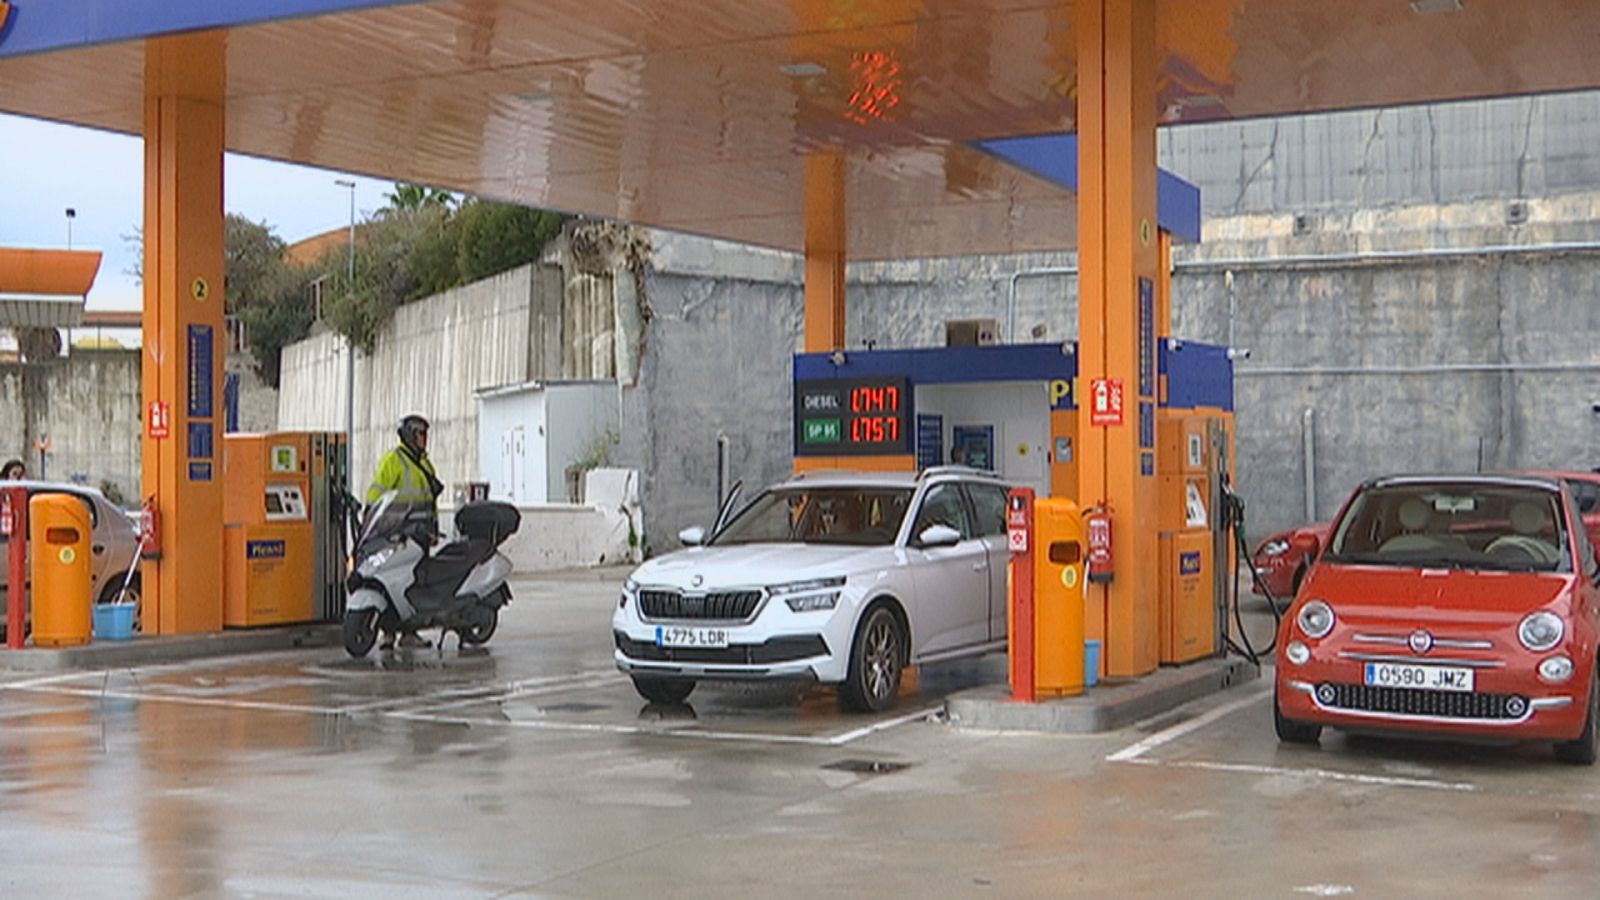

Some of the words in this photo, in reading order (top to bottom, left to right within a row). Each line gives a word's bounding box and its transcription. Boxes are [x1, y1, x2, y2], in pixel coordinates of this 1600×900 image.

[196, 280, 205, 298] 2
[804, 395, 838, 410] DIESEL
[664, 628, 696, 645] 4775
[699, 630, 725, 645] LDR
[1379, 665, 1425, 685] 0590
[1432, 669, 1467, 688] JMZ
